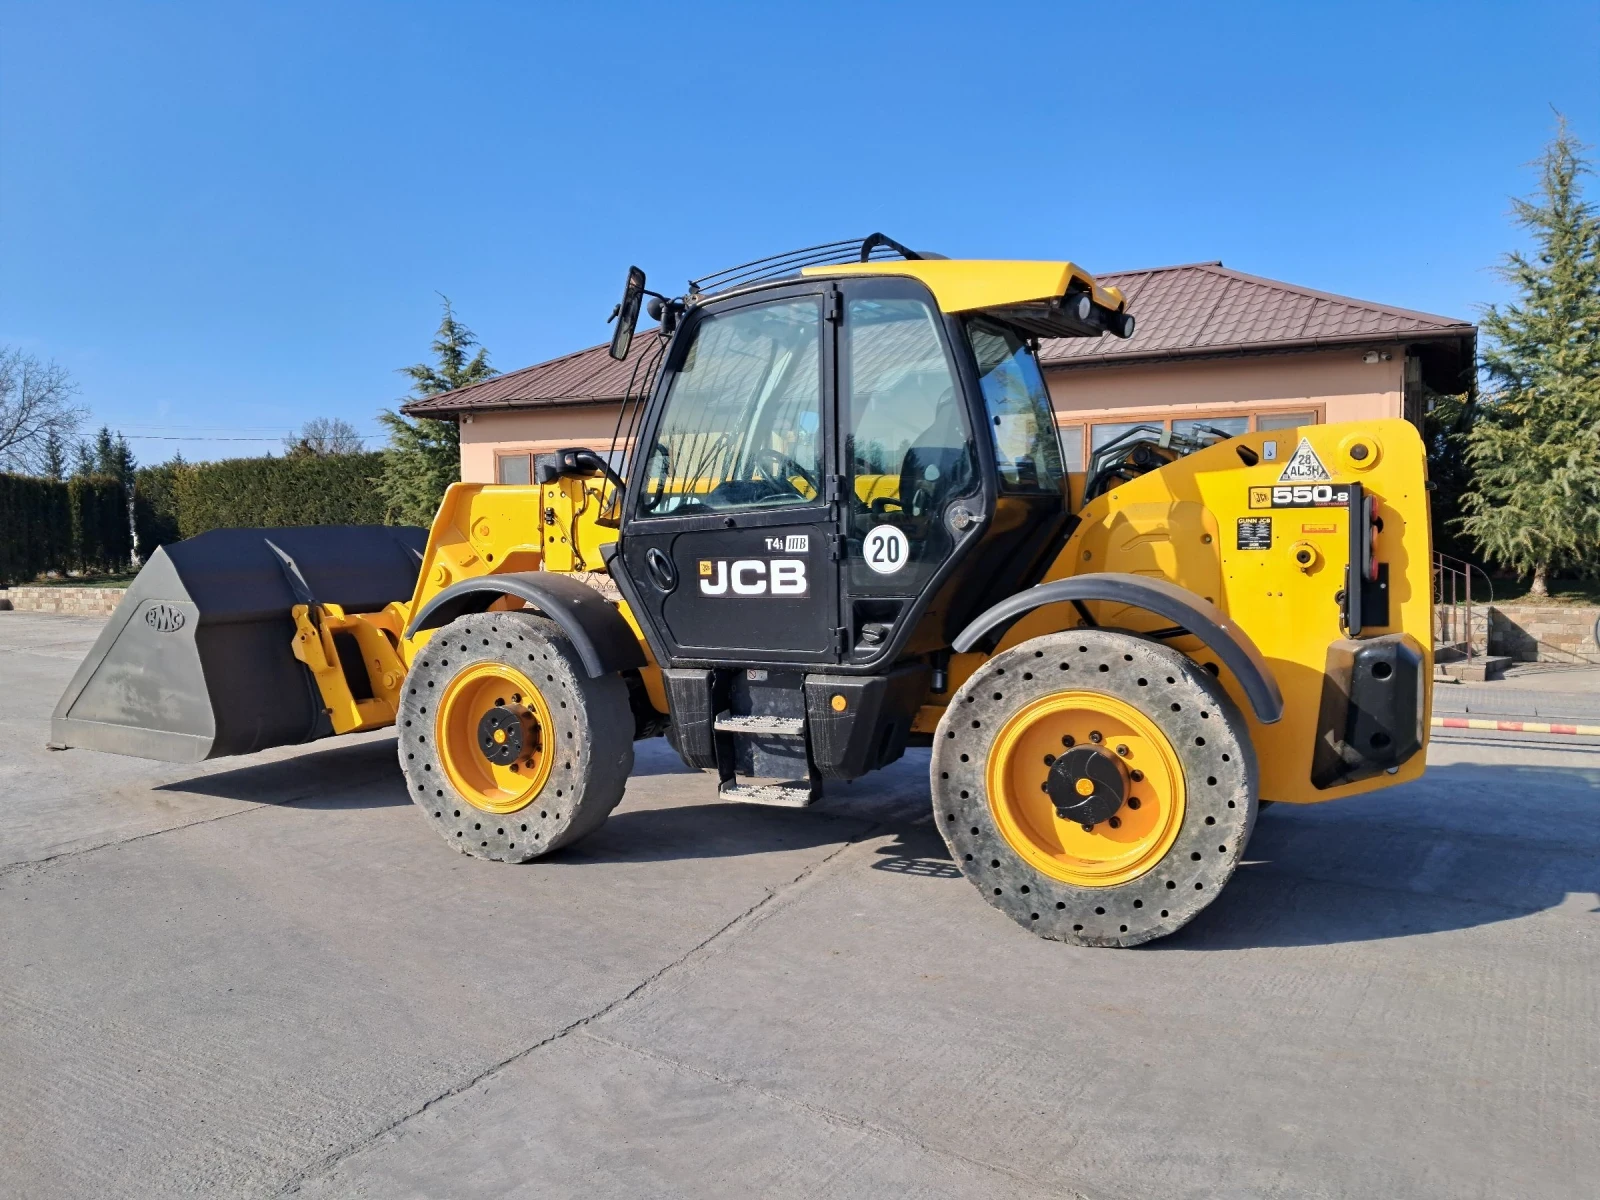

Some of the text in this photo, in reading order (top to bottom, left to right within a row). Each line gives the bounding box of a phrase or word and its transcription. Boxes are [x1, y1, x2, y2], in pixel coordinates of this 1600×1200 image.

[1298, 454, 1312, 466] 28
[765, 537, 784, 550] T4i
[872, 535, 900, 563] 20
[699, 560, 807, 595] JCB
